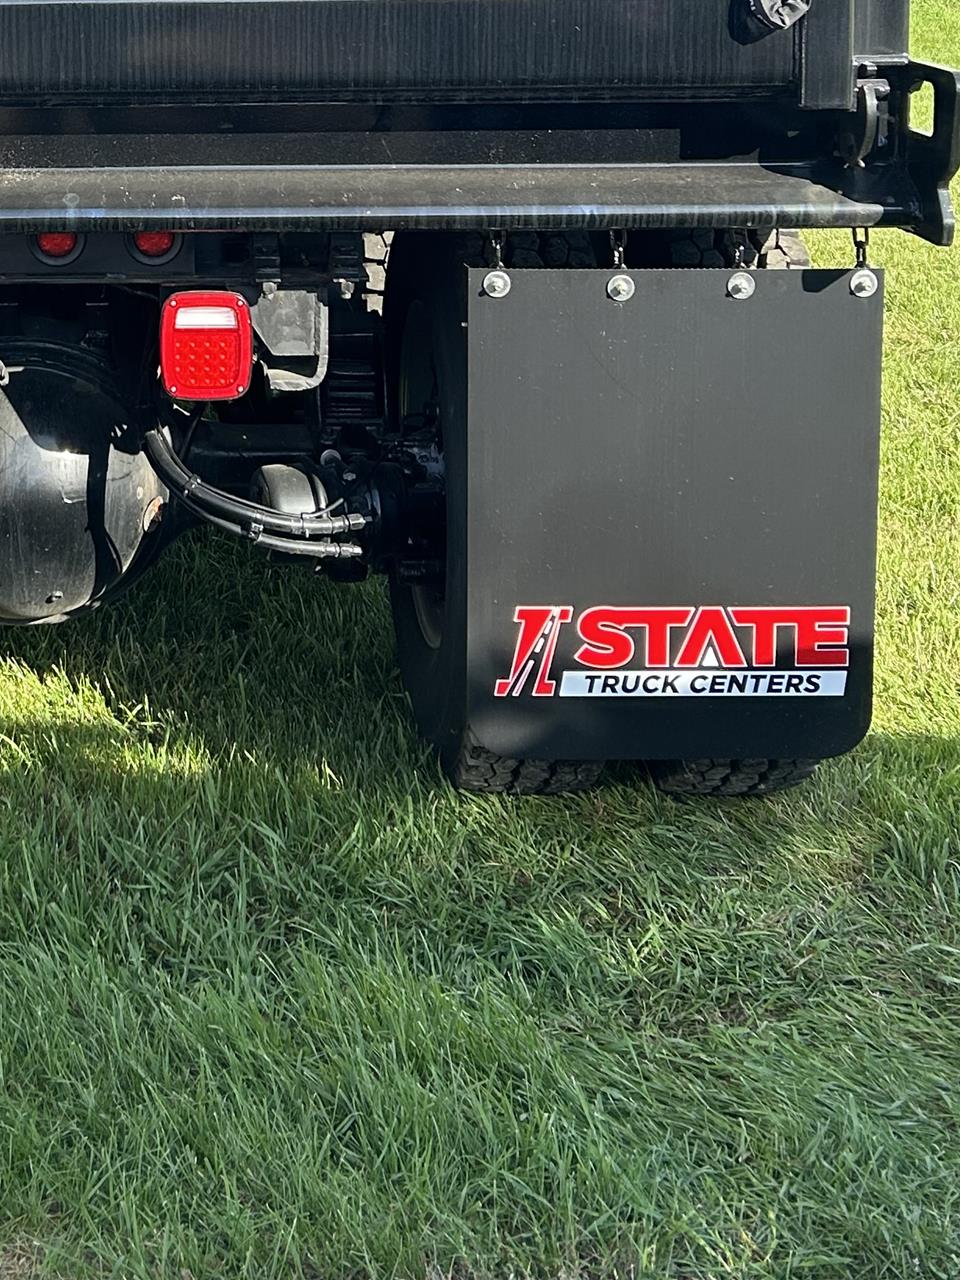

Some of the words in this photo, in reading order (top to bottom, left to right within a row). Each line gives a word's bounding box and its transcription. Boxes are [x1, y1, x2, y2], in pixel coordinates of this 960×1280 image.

[573, 606, 851, 669] STATE
[585, 674, 682, 694] TRUCK
[689, 674, 821, 694] CENTERS
